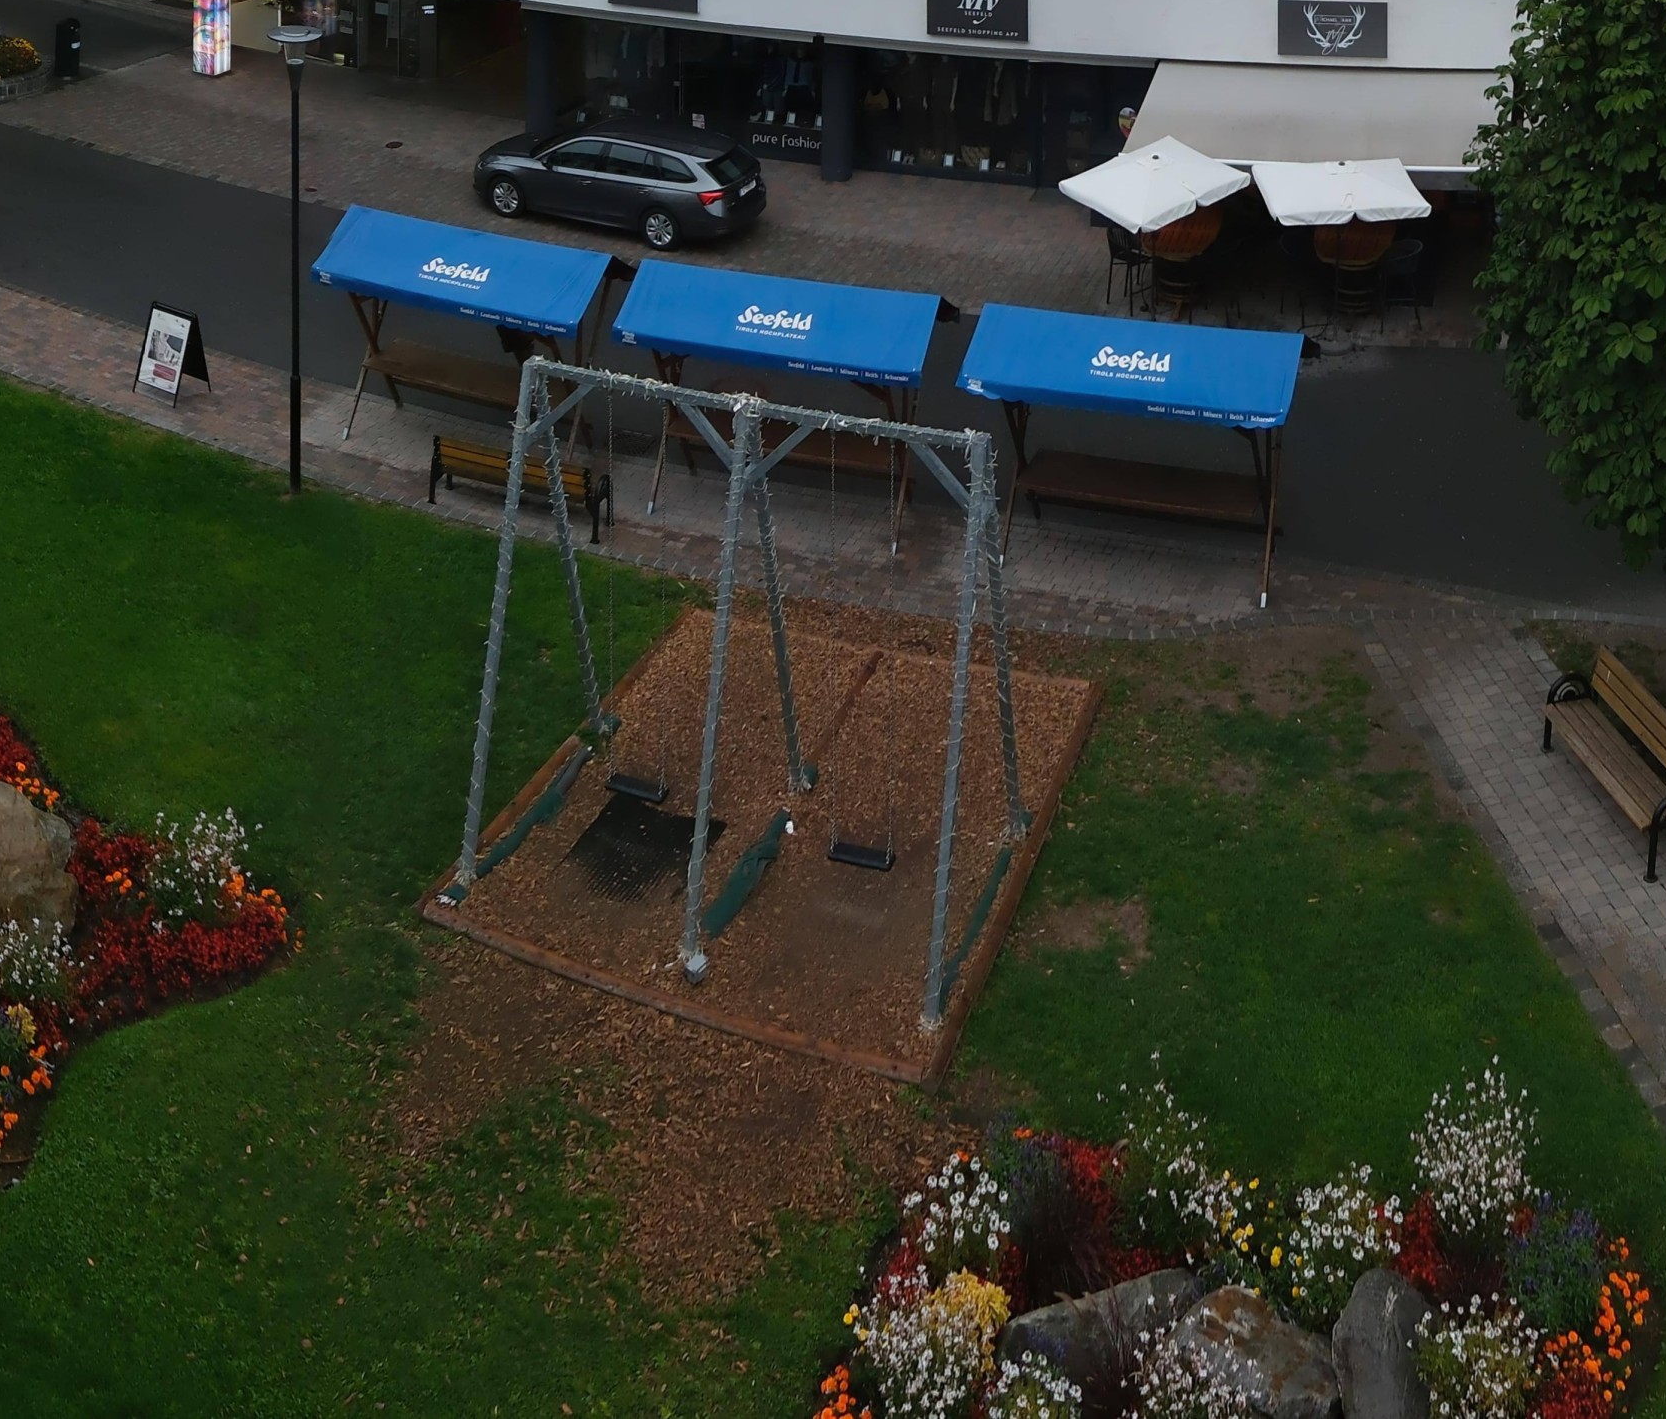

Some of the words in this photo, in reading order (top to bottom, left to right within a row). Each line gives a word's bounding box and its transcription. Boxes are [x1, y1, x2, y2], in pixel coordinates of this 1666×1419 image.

[937, 26, 965, 34] SEEFELD
[968, 28, 1003, 36] SHOPPING
[753, 134, 778, 144] pure
[423, 257, 491, 283] Seefeld
[737, 305, 813, 331] Seefeld
[1091, 345, 1170, 373] Seefeld
[1090, 369, 1113, 378] TIROLS
[1115, 371, 1165, 382] HOCHPLATEAU
